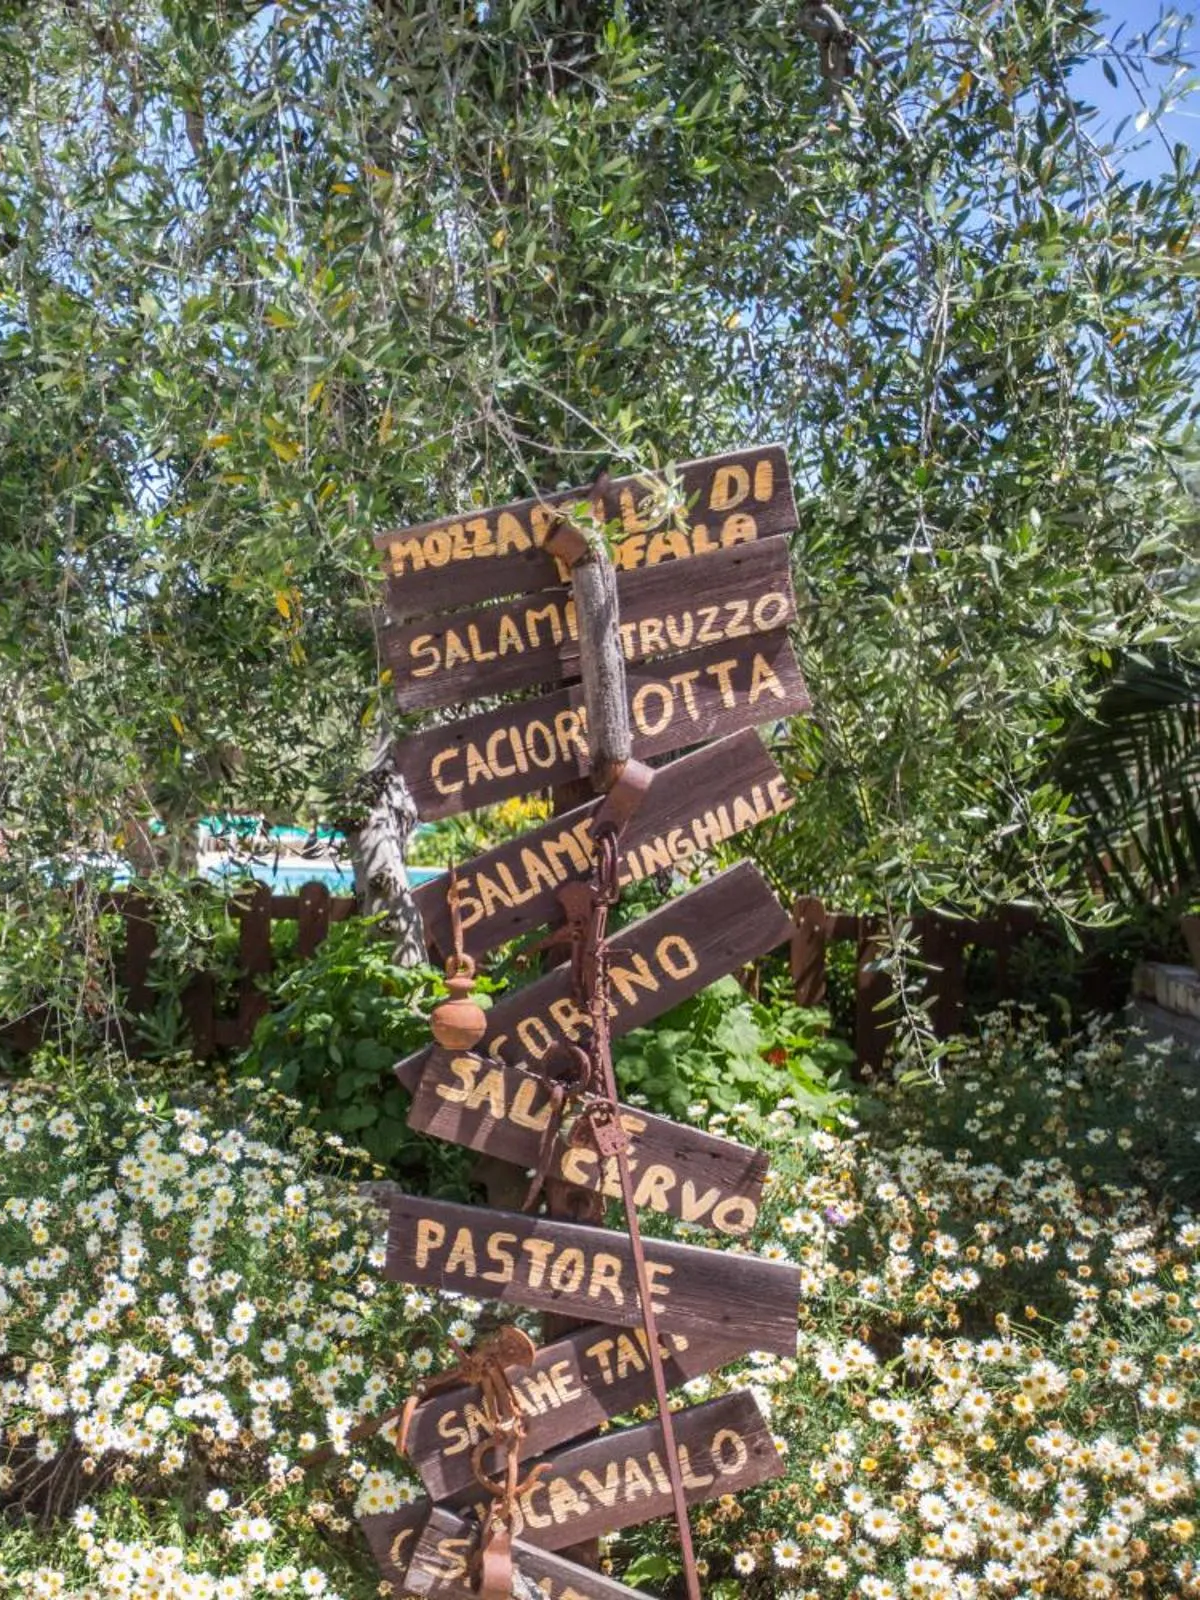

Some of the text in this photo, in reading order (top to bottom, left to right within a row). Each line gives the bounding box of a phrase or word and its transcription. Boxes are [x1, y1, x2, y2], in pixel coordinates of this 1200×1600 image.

[708, 459, 774, 511] DI
[619, 591, 789, 660] TRUZZO
[561, 1148, 757, 1234] CERVO
[416, 1218, 675, 1314] PASTORE
